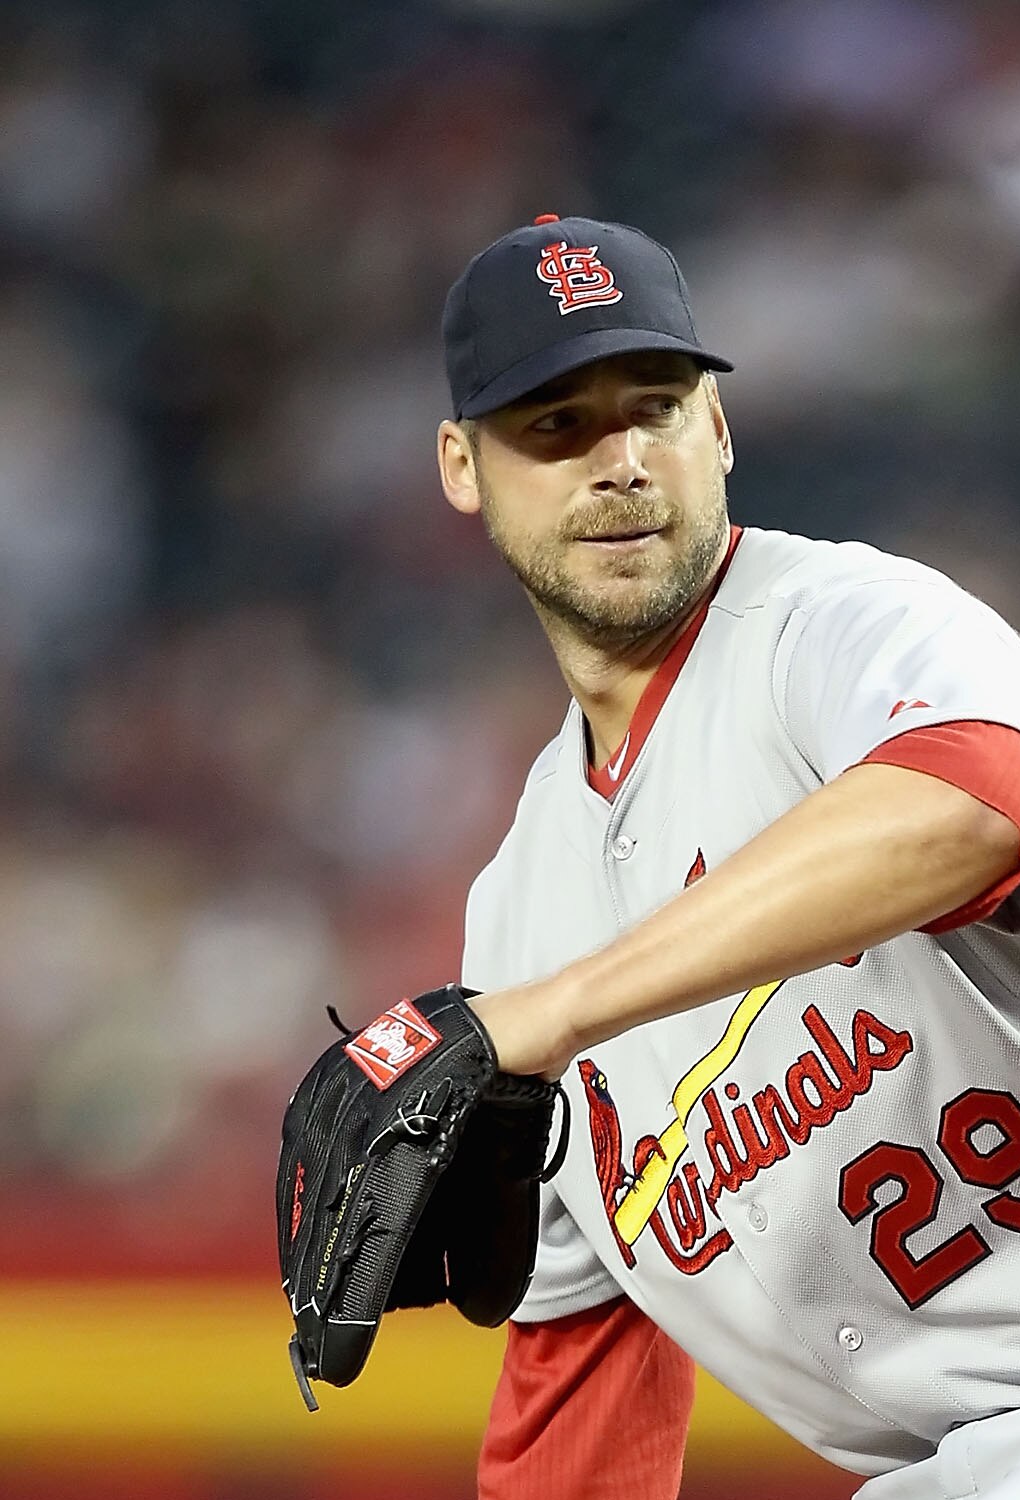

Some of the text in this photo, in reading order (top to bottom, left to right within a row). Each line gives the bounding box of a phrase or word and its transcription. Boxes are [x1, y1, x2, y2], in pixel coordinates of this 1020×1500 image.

[631, 1003, 914, 1276] Cardinals
[317, 1263, 329, 1292] THE
[324, 1226, 340, 1262] GOLD
[337, 1185, 353, 1225] GLOVE
